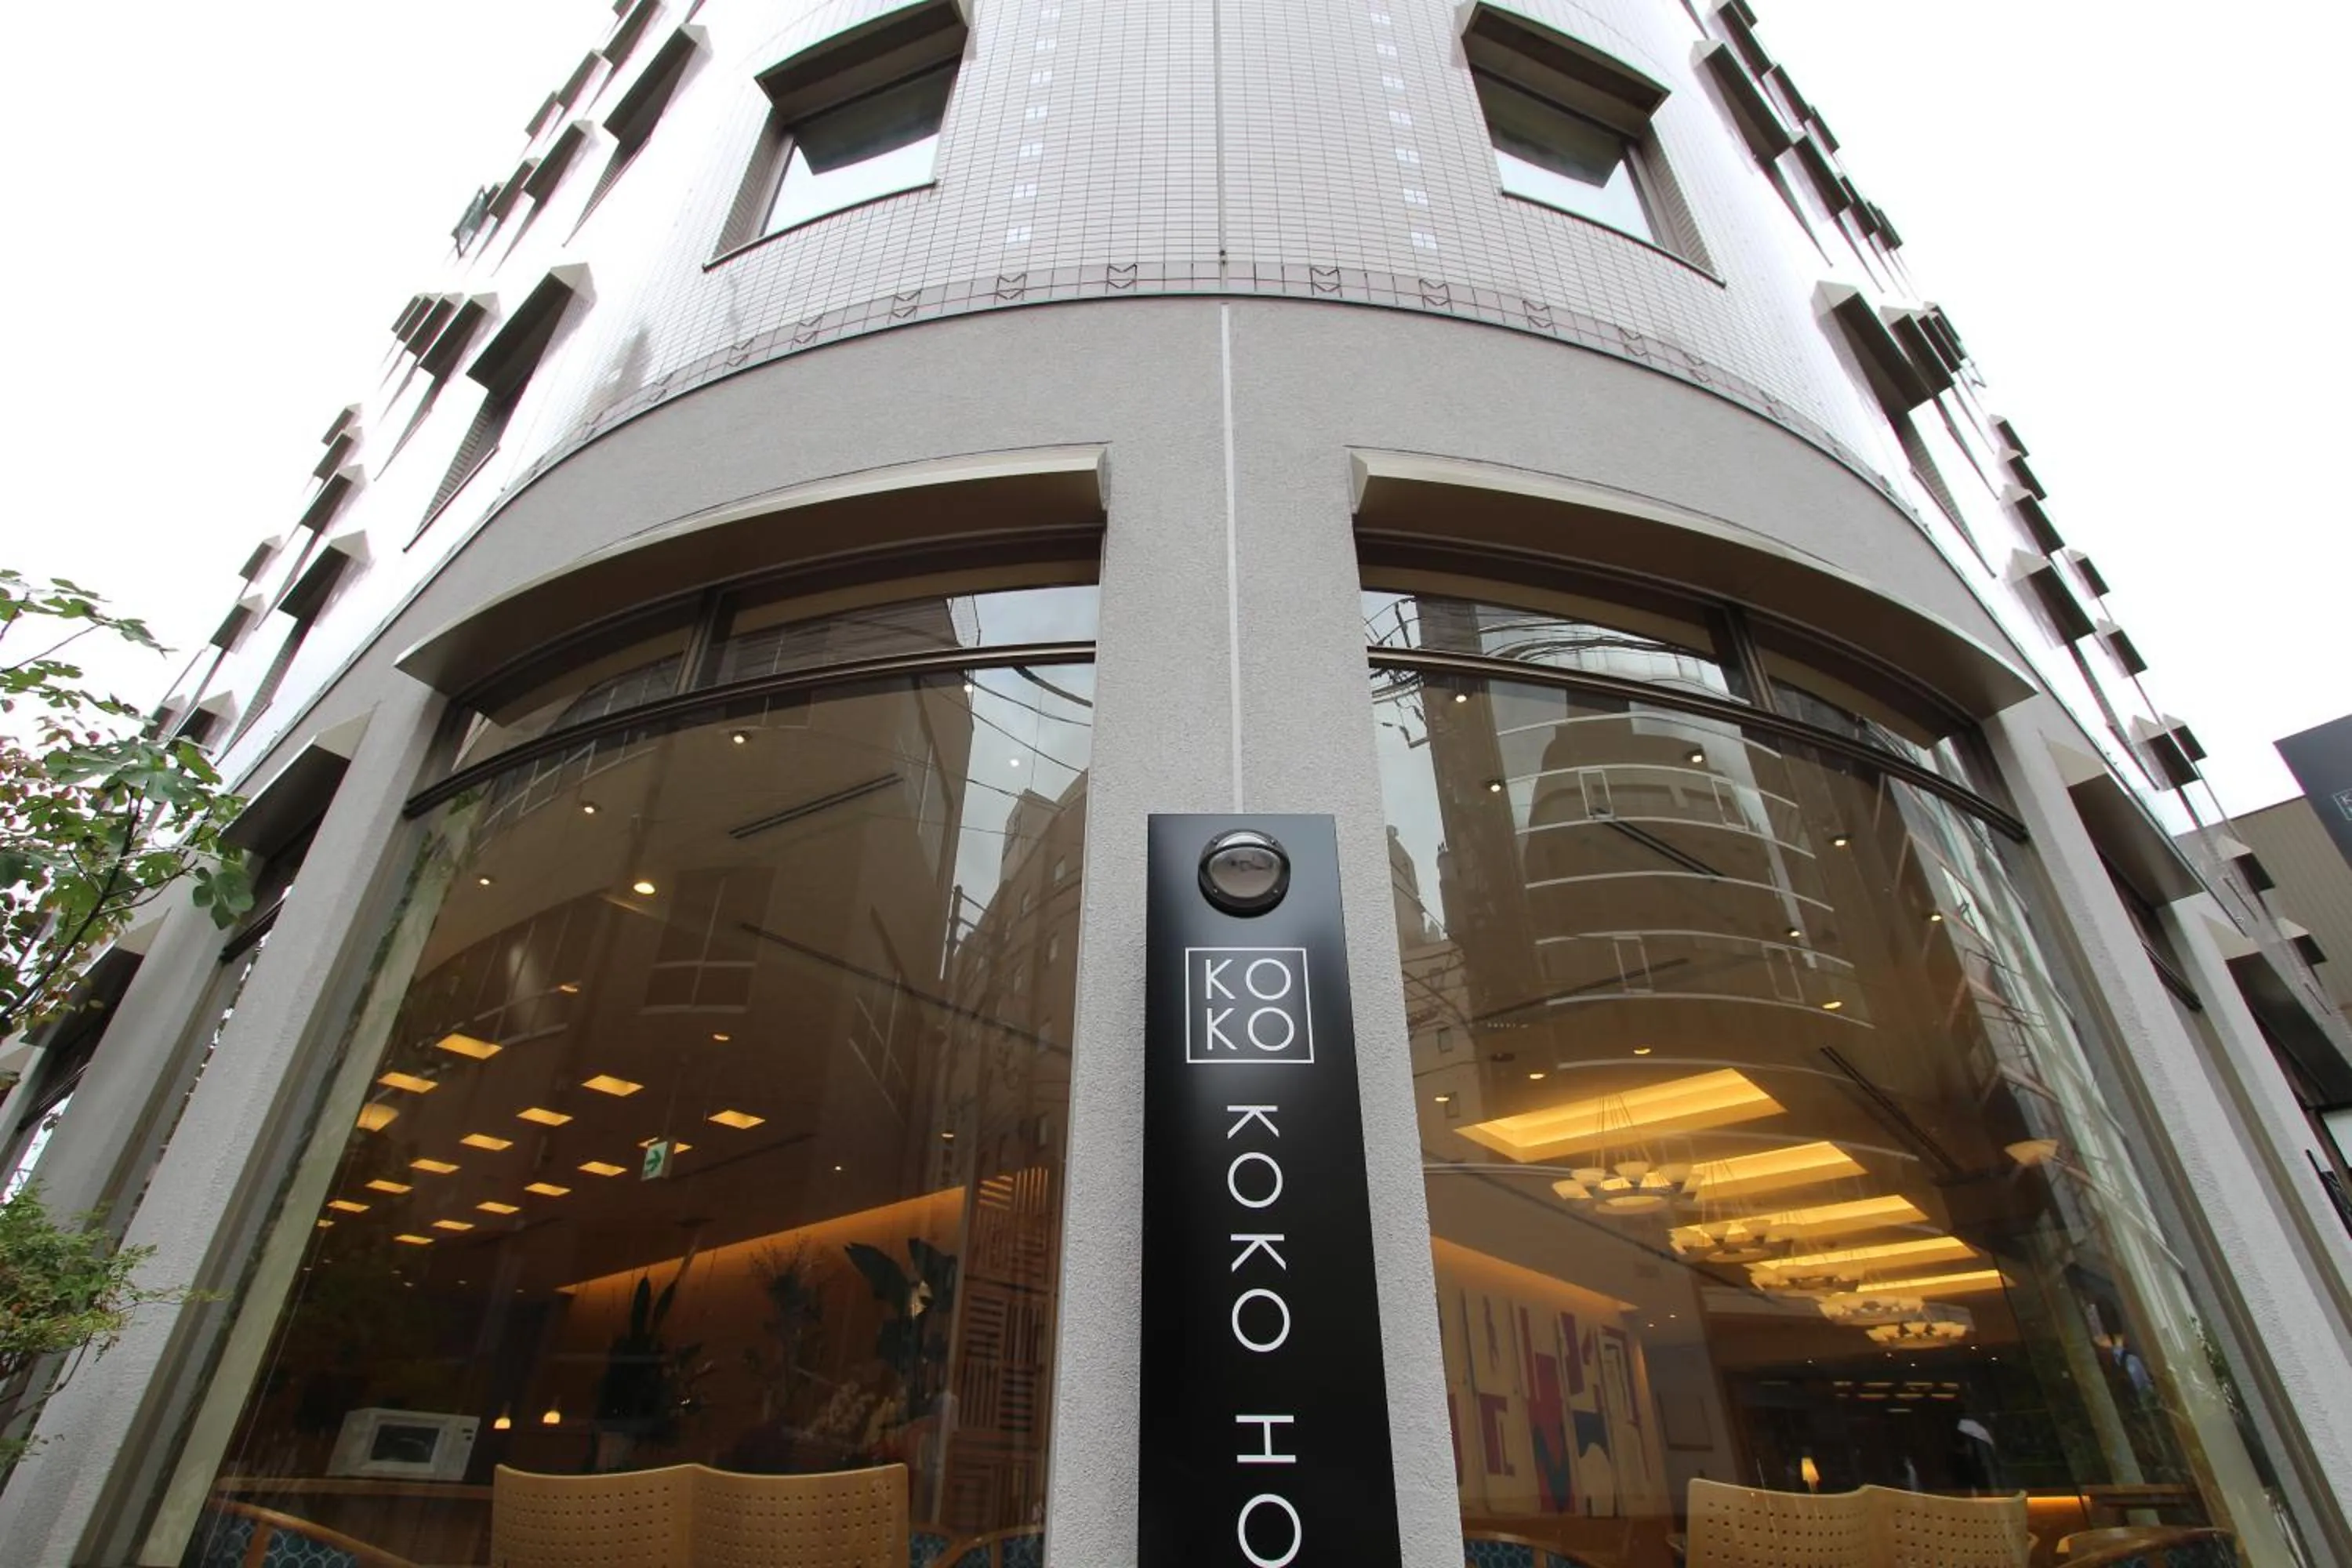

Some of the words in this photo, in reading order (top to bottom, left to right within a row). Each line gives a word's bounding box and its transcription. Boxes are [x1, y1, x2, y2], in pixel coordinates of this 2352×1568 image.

[1205, 957, 1292, 1001] KO
[1206, 1006, 1296, 1051] KO
[1226, 1104, 1291, 1353] KOKO
[1235, 1414, 1302, 1568] HO
